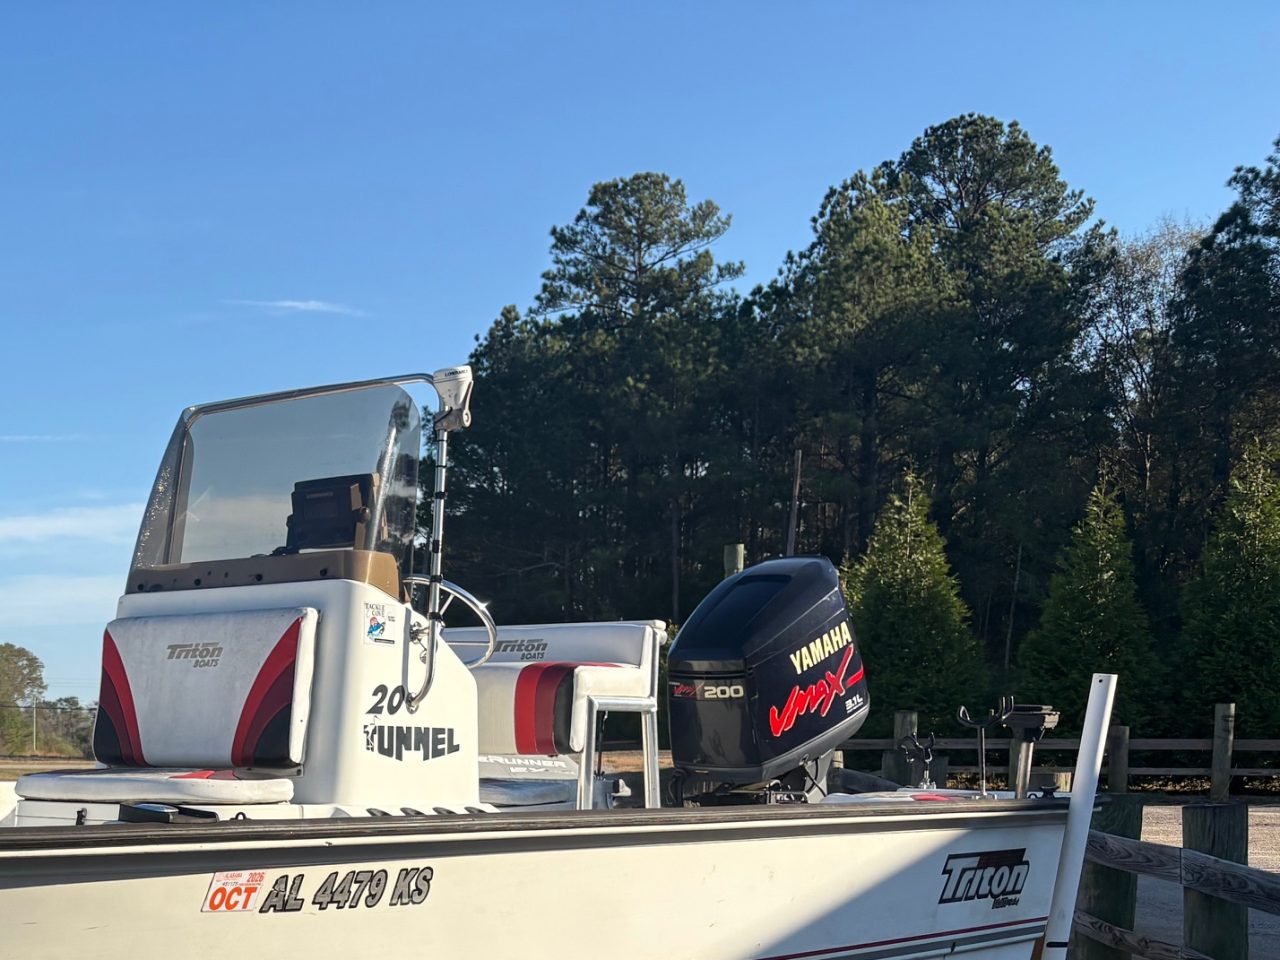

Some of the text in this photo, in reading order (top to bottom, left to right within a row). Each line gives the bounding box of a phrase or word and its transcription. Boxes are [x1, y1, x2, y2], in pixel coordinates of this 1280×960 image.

[167, 642, 224, 659] Triton
[495, 639, 548, 652] Triton
[789, 620, 852, 675] YAMAHA
[365, 684, 406, 716] 20
[704, 685, 744, 698] 200
[363, 725, 460, 762] TUNNEL
[259, 866, 434, 913] AL 4479 KS
[938, 848, 1030, 904] Triton
[209, 886, 258, 911] OCT
